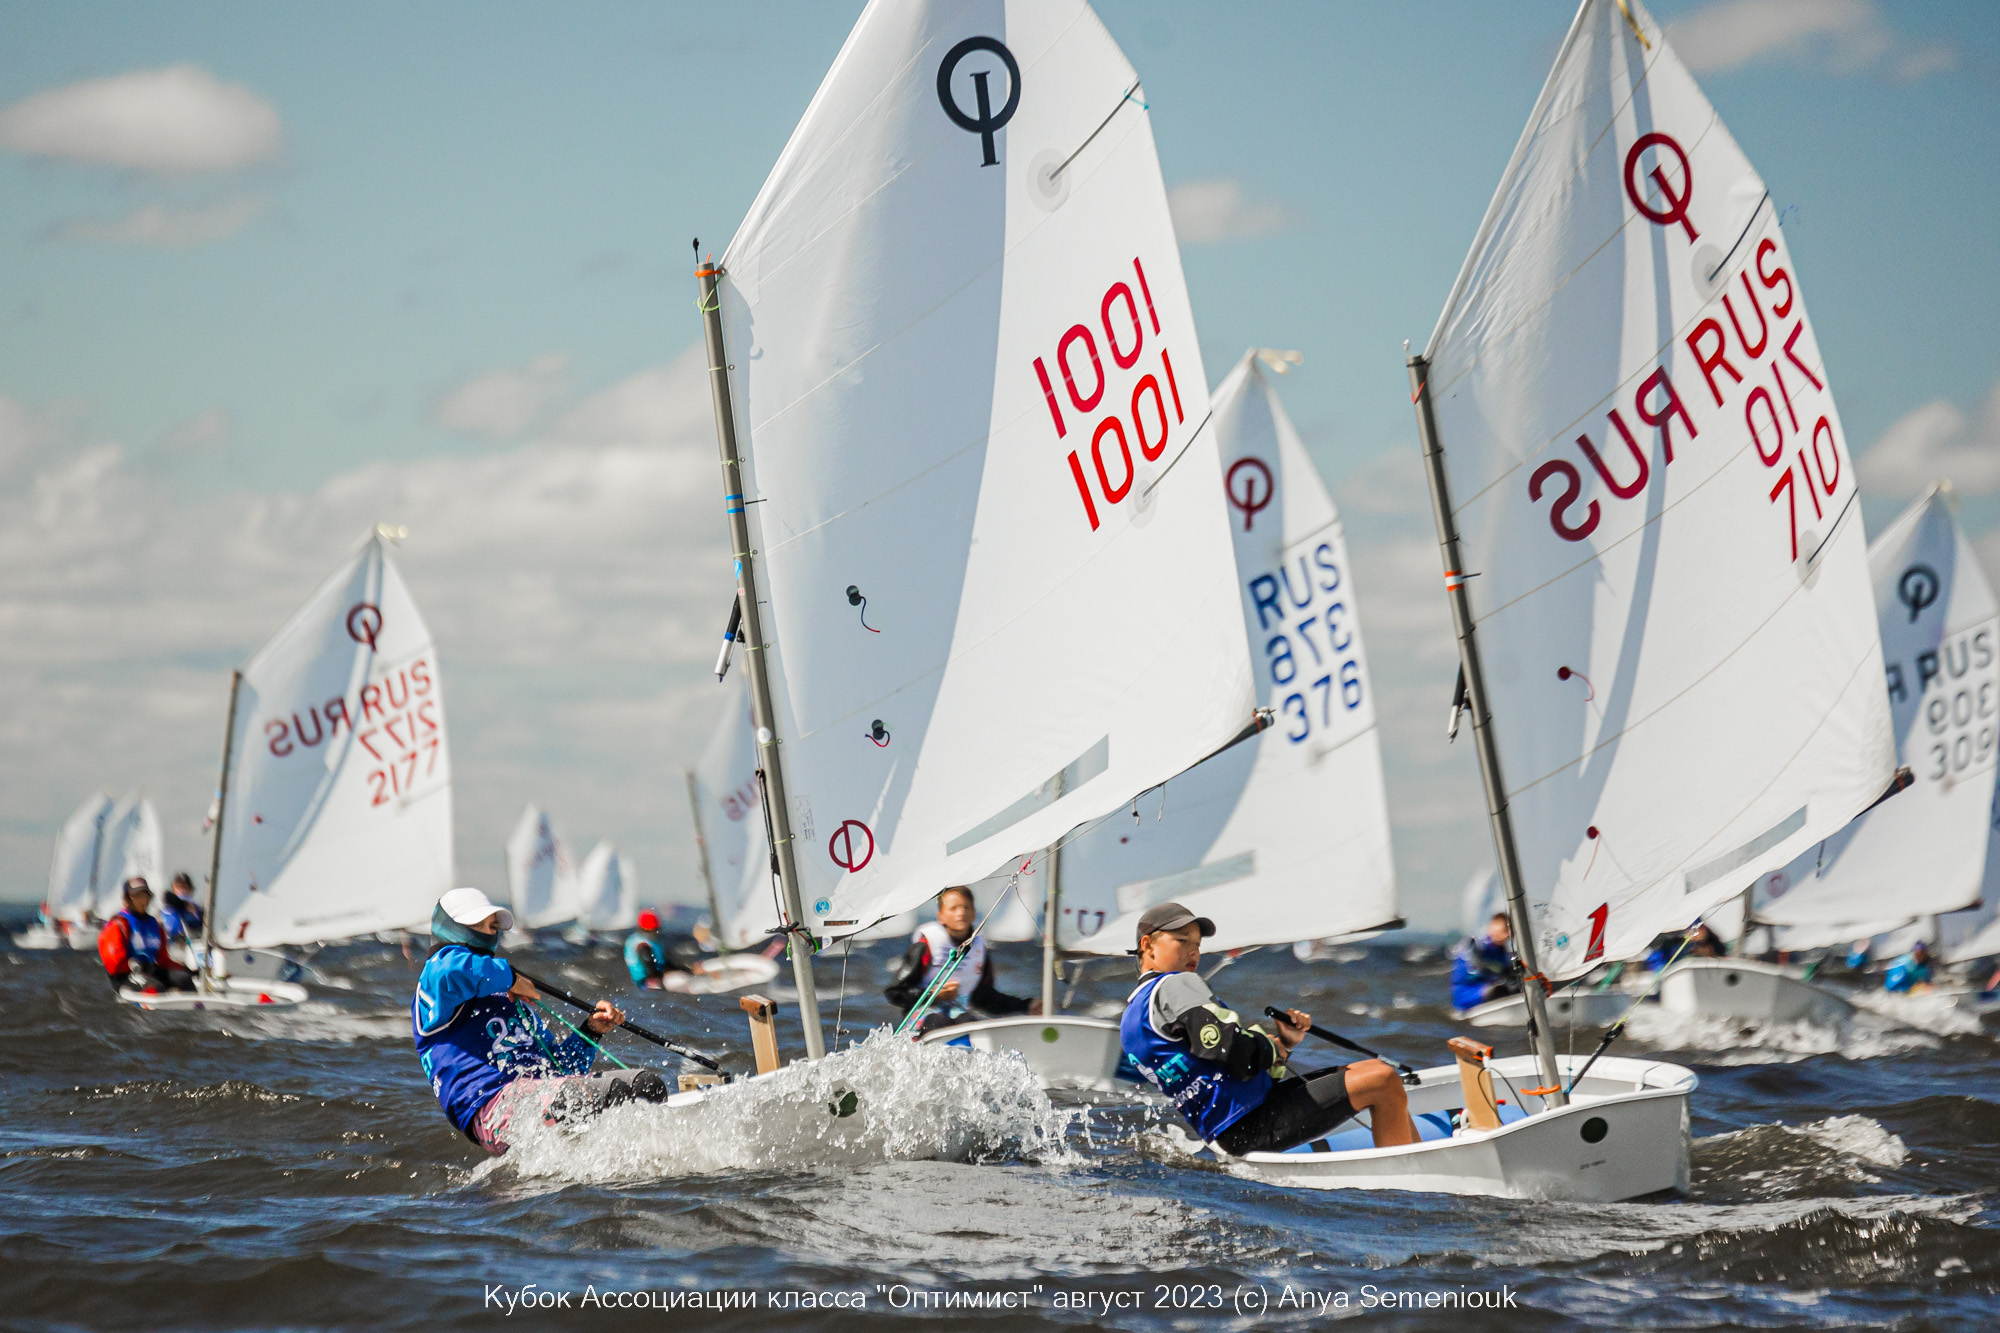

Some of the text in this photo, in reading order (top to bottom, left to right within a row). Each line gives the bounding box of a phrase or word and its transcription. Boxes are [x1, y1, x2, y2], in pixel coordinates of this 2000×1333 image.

[1032, 255, 1162, 440] 1001
[1685, 237, 1793, 408] RUS
[1067, 346, 1185, 533] 1001
[1768, 414, 1841, 564] 710
[1248, 542, 1341, 633] RUS
[359, 659, 431, 723] RUS
[1282, 659, 1363, 744] 376
[1916, 631, 1994, 694] RUS
[366, 736, 439, 808] 2177
[1928, 726, 1996, 782] 309
